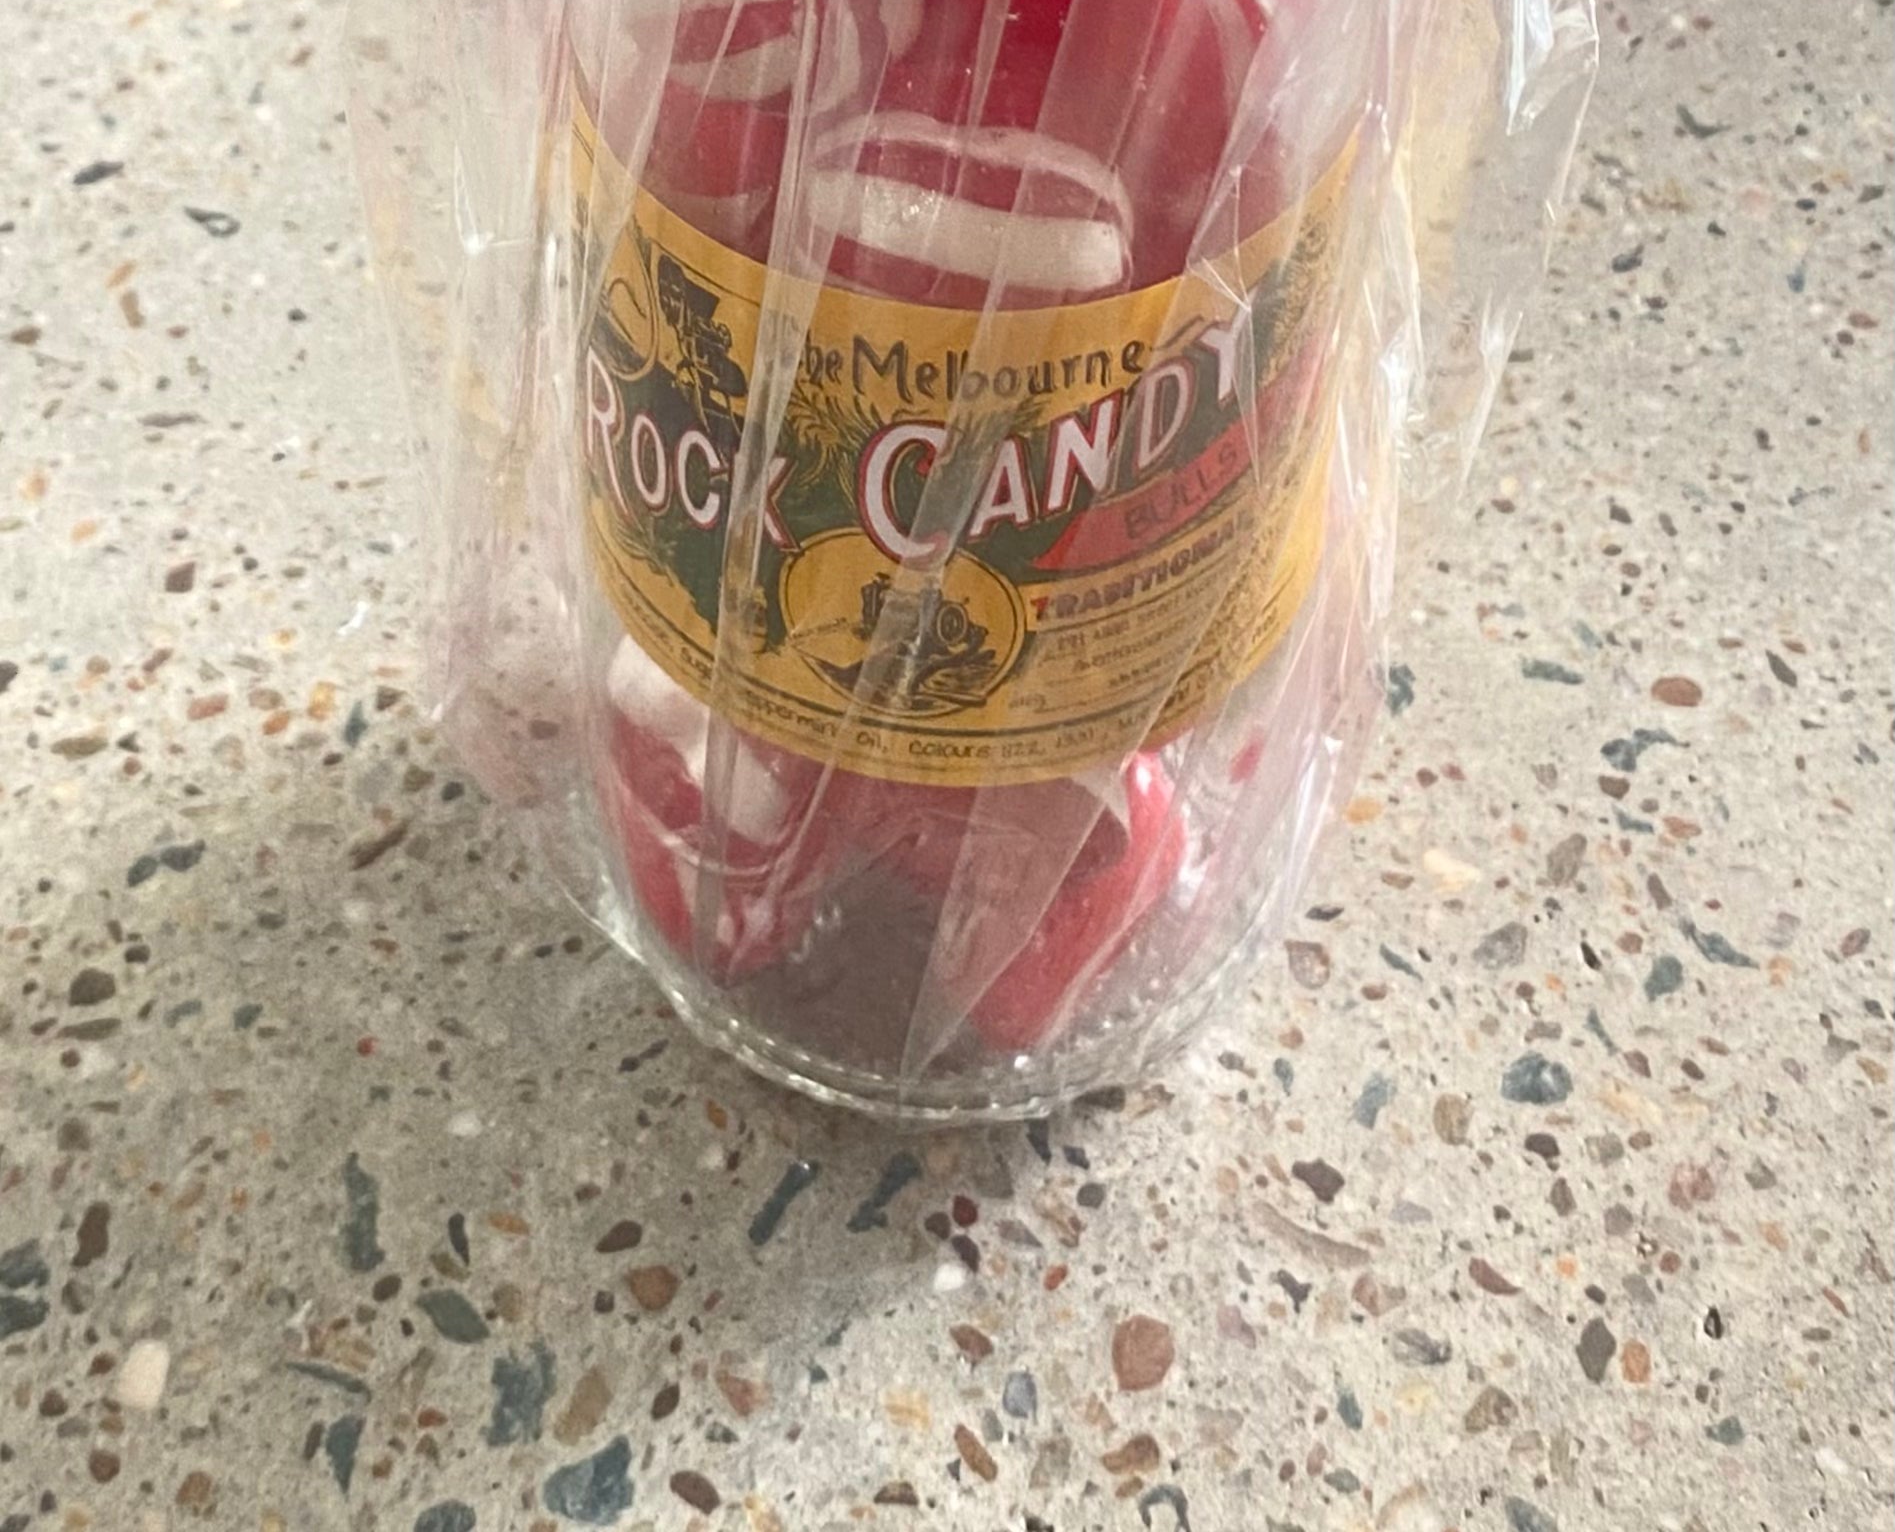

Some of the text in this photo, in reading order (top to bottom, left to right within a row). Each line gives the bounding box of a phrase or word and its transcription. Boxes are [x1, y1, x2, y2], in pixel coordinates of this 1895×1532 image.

[583, 294, 1252, 570] ROCK CANDY
[851, 334, 1145, 404] Melbourne
